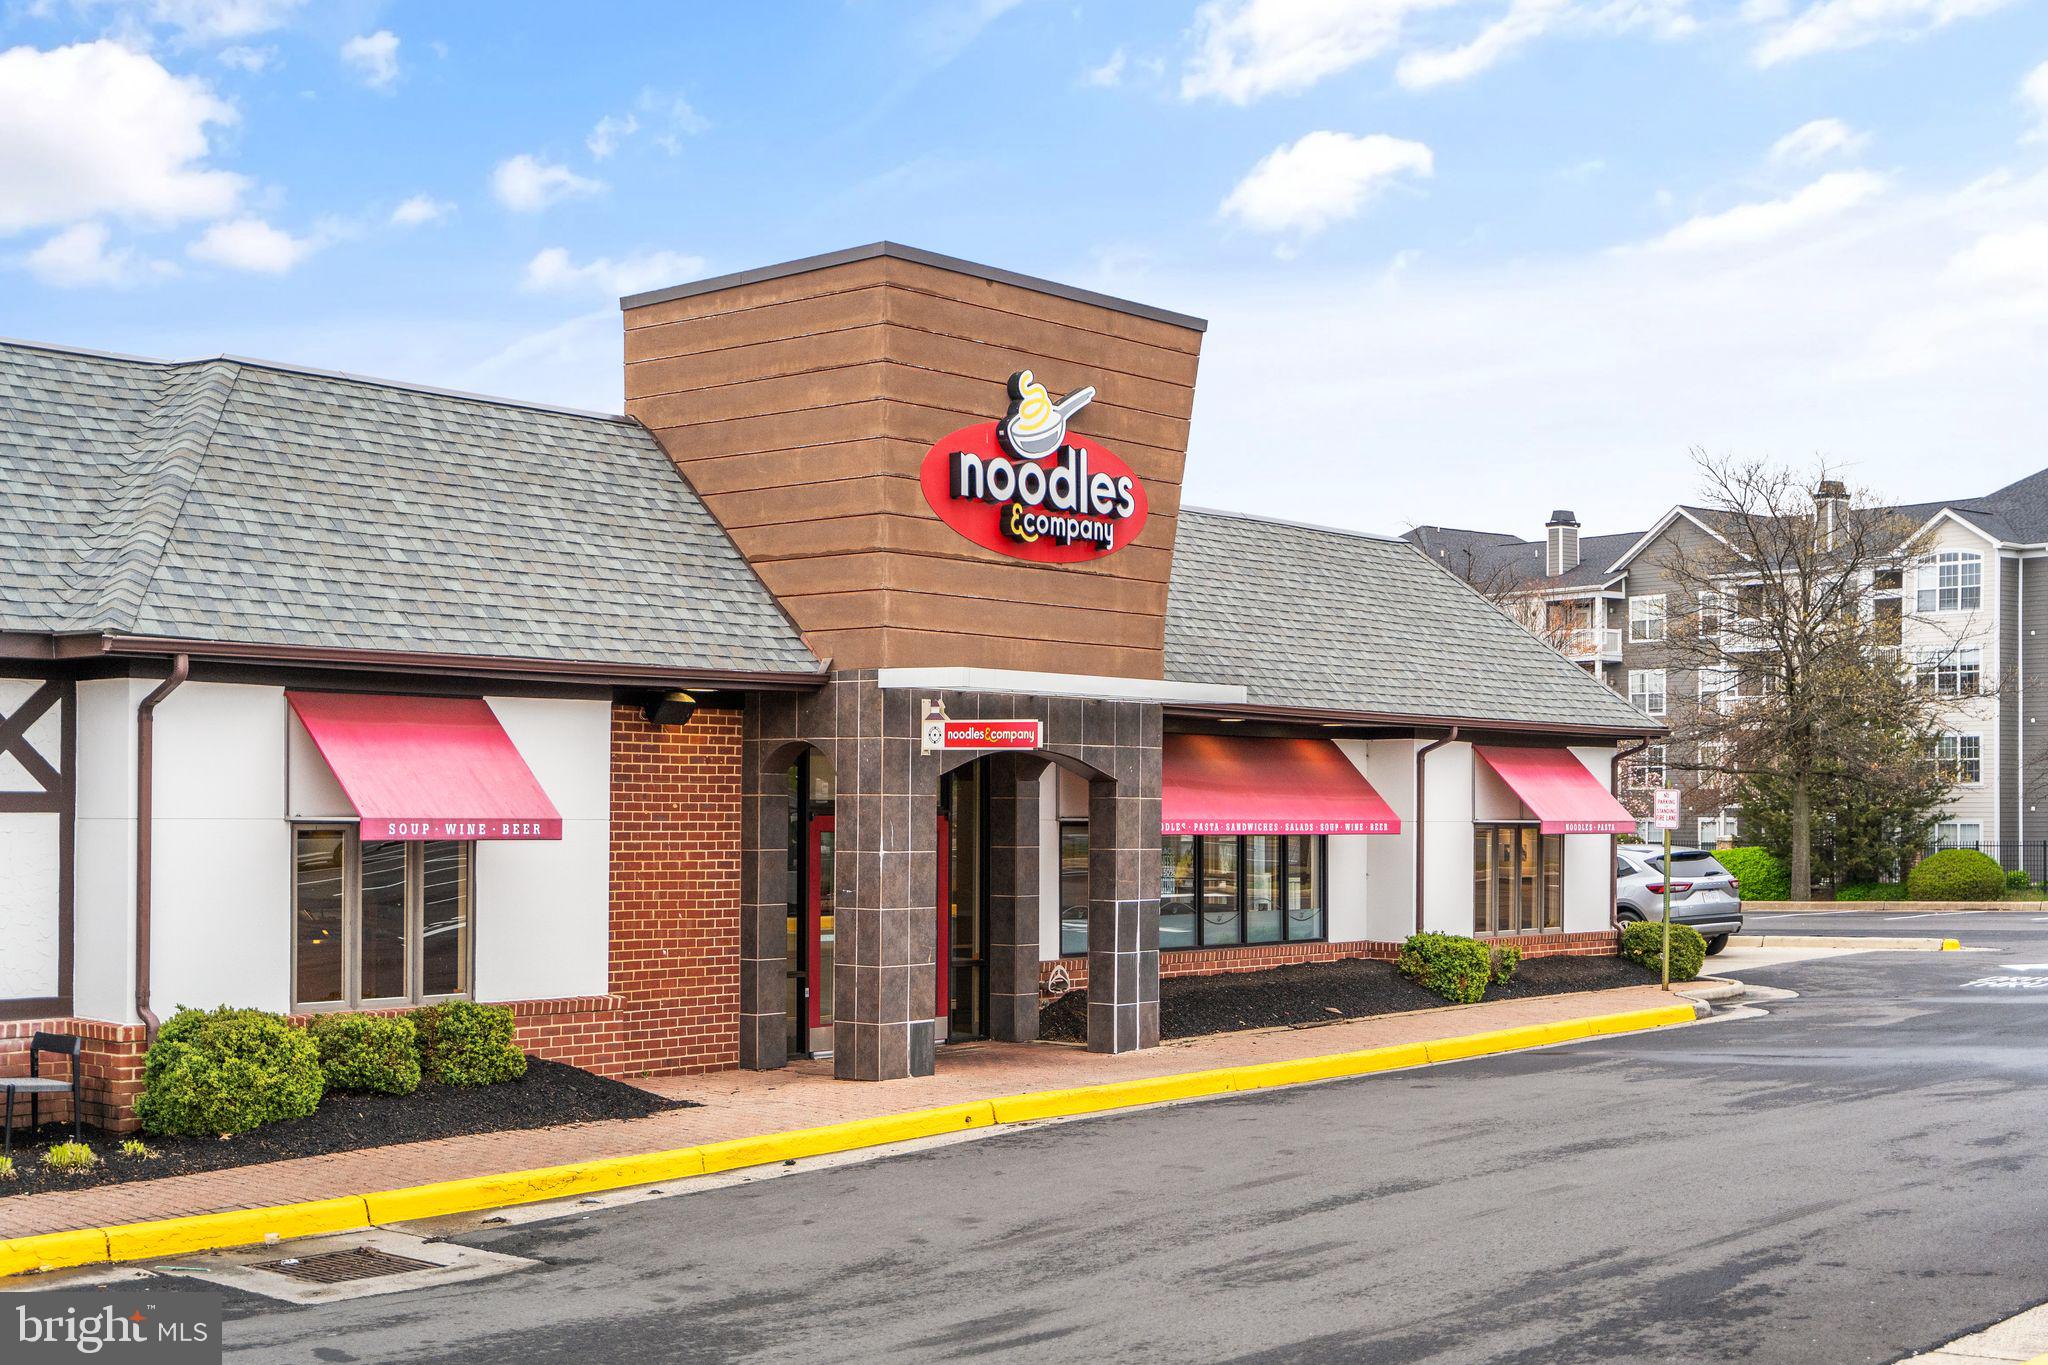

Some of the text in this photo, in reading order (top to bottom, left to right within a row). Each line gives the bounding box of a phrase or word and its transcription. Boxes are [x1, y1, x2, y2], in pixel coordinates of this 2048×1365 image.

[959, 445, 1135, 518] noodles
[388, 823, 541, 835] SOUP WINE BEER
[1193, 822, 1220, 832] PASTA
[1225, 822, 1278, 832] SANDWICHES
[1284, 822, 1314, 832] SALADS
[1319, 822, 1339, 832] SOUP
[1344, 822, 1364, 832] WINE
[1369, 822, 1389, 832] BEER
[1565, 823, 1616, 832] NOODLES PASTA
